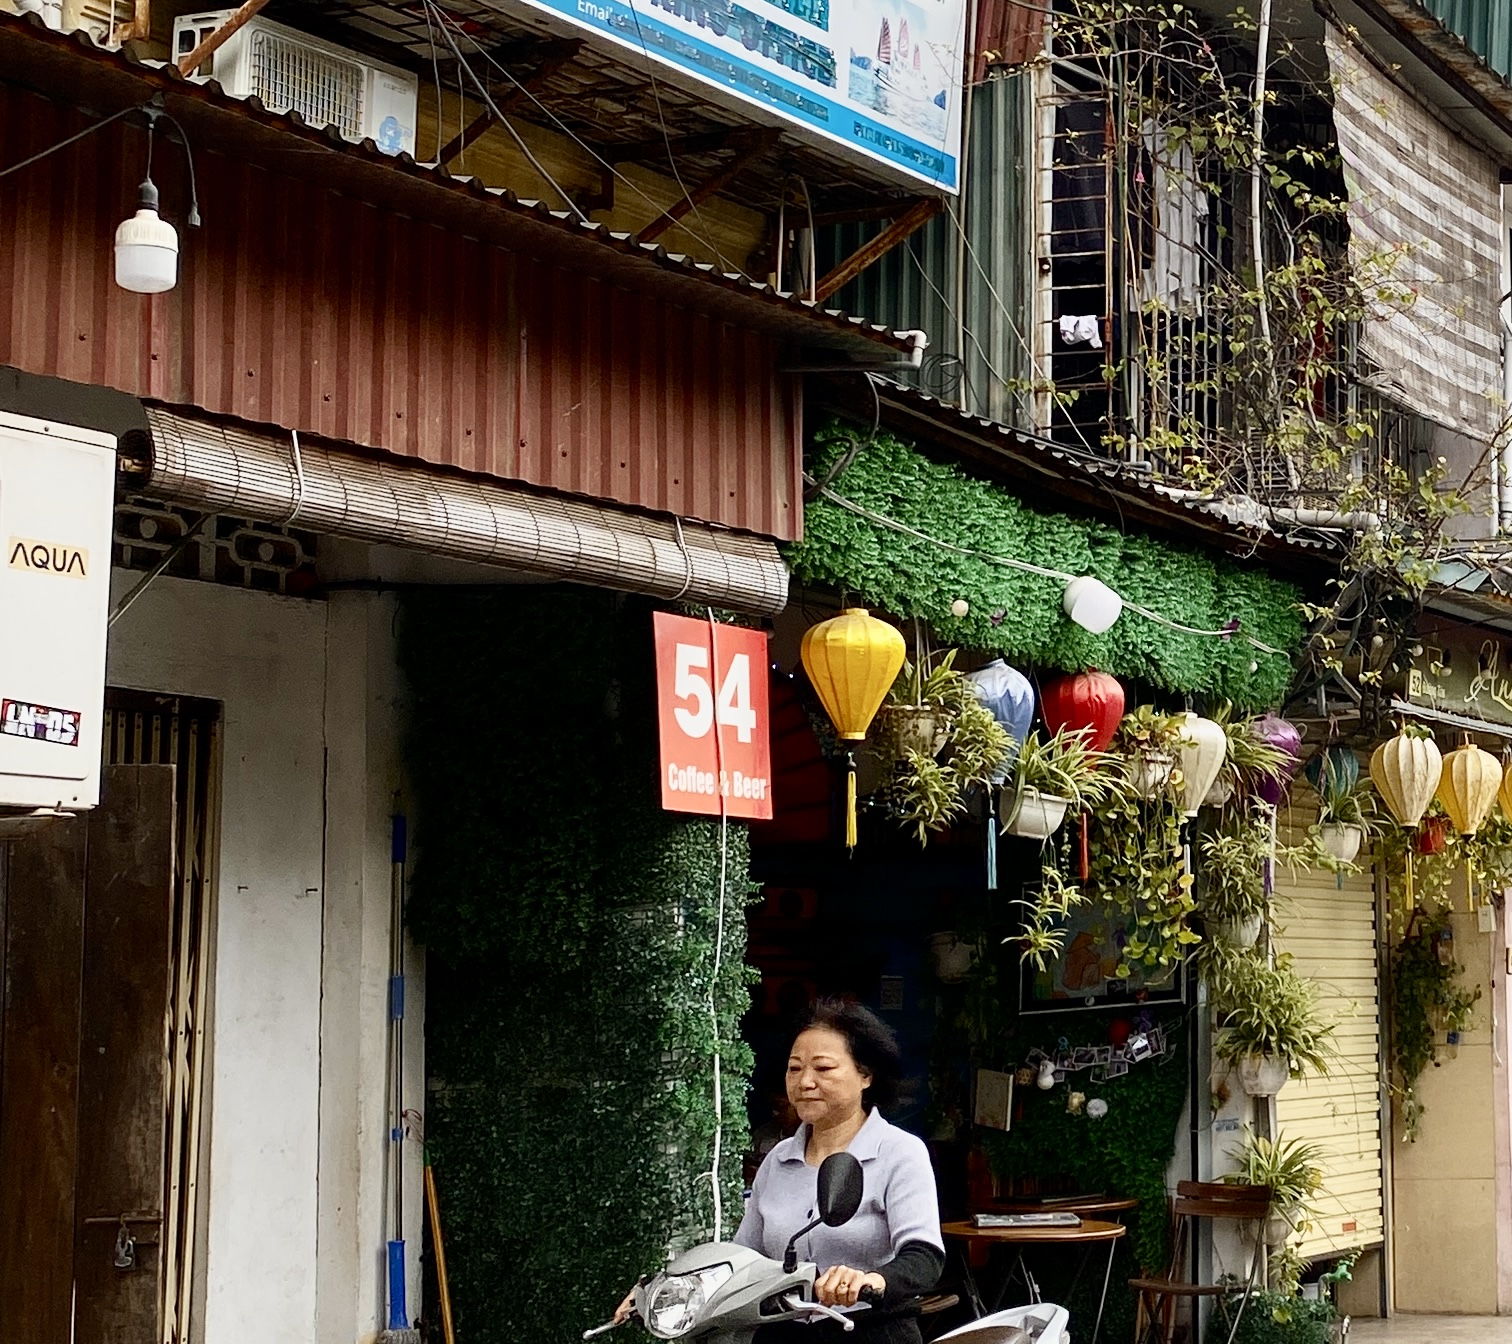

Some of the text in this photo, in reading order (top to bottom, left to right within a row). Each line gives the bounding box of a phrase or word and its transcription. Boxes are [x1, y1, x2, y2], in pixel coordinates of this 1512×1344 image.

[10, 542, 86, 576] AQUA
[673, 642, 757, 744] 54
[668, 762, 715, 796] Coffee
[732, 770, 767, 801] Beer
